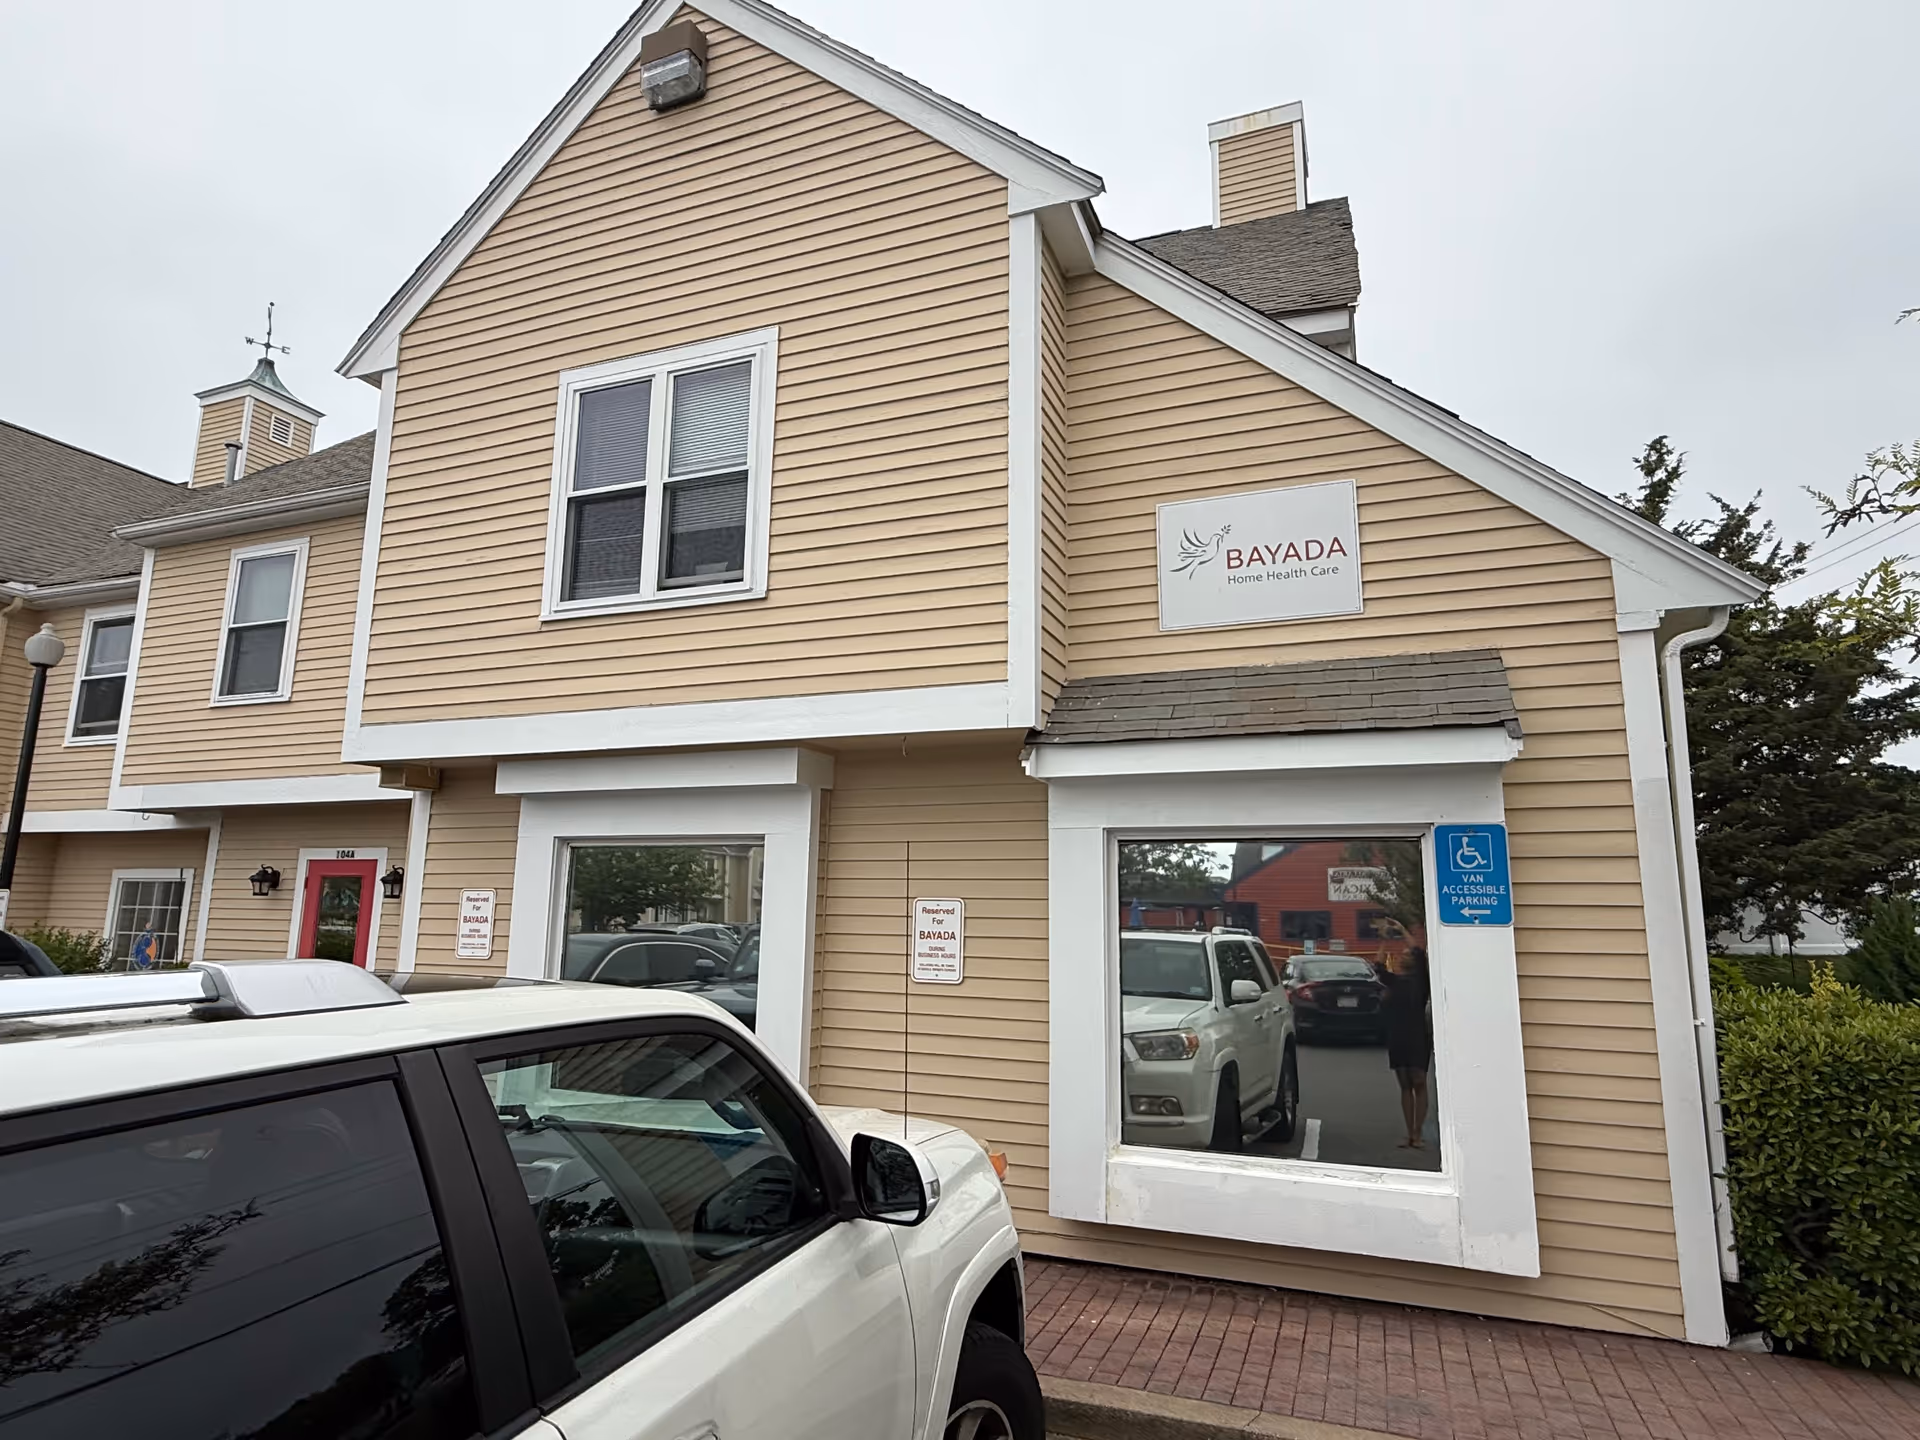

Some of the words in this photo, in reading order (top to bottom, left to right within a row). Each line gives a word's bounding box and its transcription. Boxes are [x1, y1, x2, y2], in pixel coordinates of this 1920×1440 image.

[1226, 537, 1347, 569] BAYADA
[1227, 572, 1263, 584] Home
[1266, 567, 1307, 581] Health
[1311, 565, 1339, 576] Care
[336, 850, 355, 859] 104A
[1462, 874, 1484, 883] VAN
[1442, 885, 1506, 894] ACCESSIBLE
[1452, 896, 1498, 905] PARKING
[922, 907, 955, 915] Reserved
[932, 917, 944, 925] For
[919, 931, 956, 940] BAYADA
